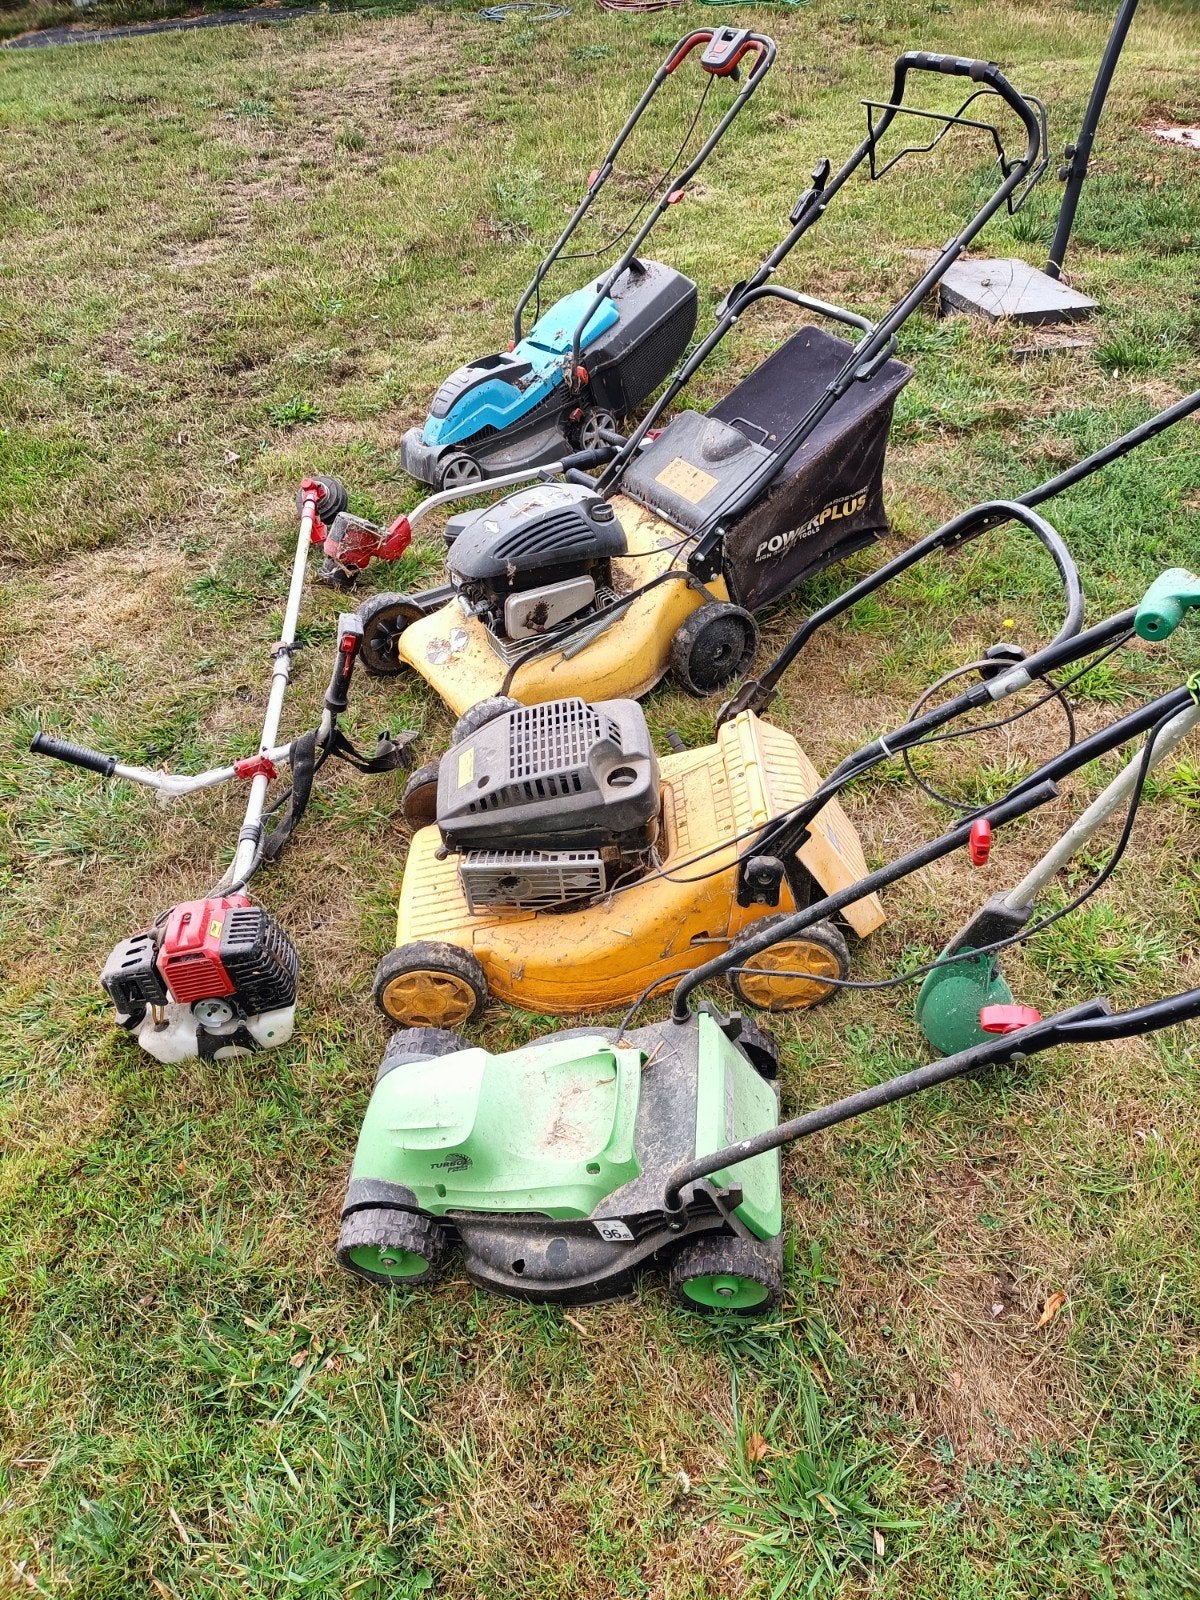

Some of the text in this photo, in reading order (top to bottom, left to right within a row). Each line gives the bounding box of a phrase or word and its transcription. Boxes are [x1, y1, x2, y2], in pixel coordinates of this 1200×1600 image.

[756, 494, 867, 557] POWERPLUS
[799, 527, 820, 539] TOOLS
[431, 1161, 463, 1169] TURBO
[603, 1229, 621, 1239] 96
